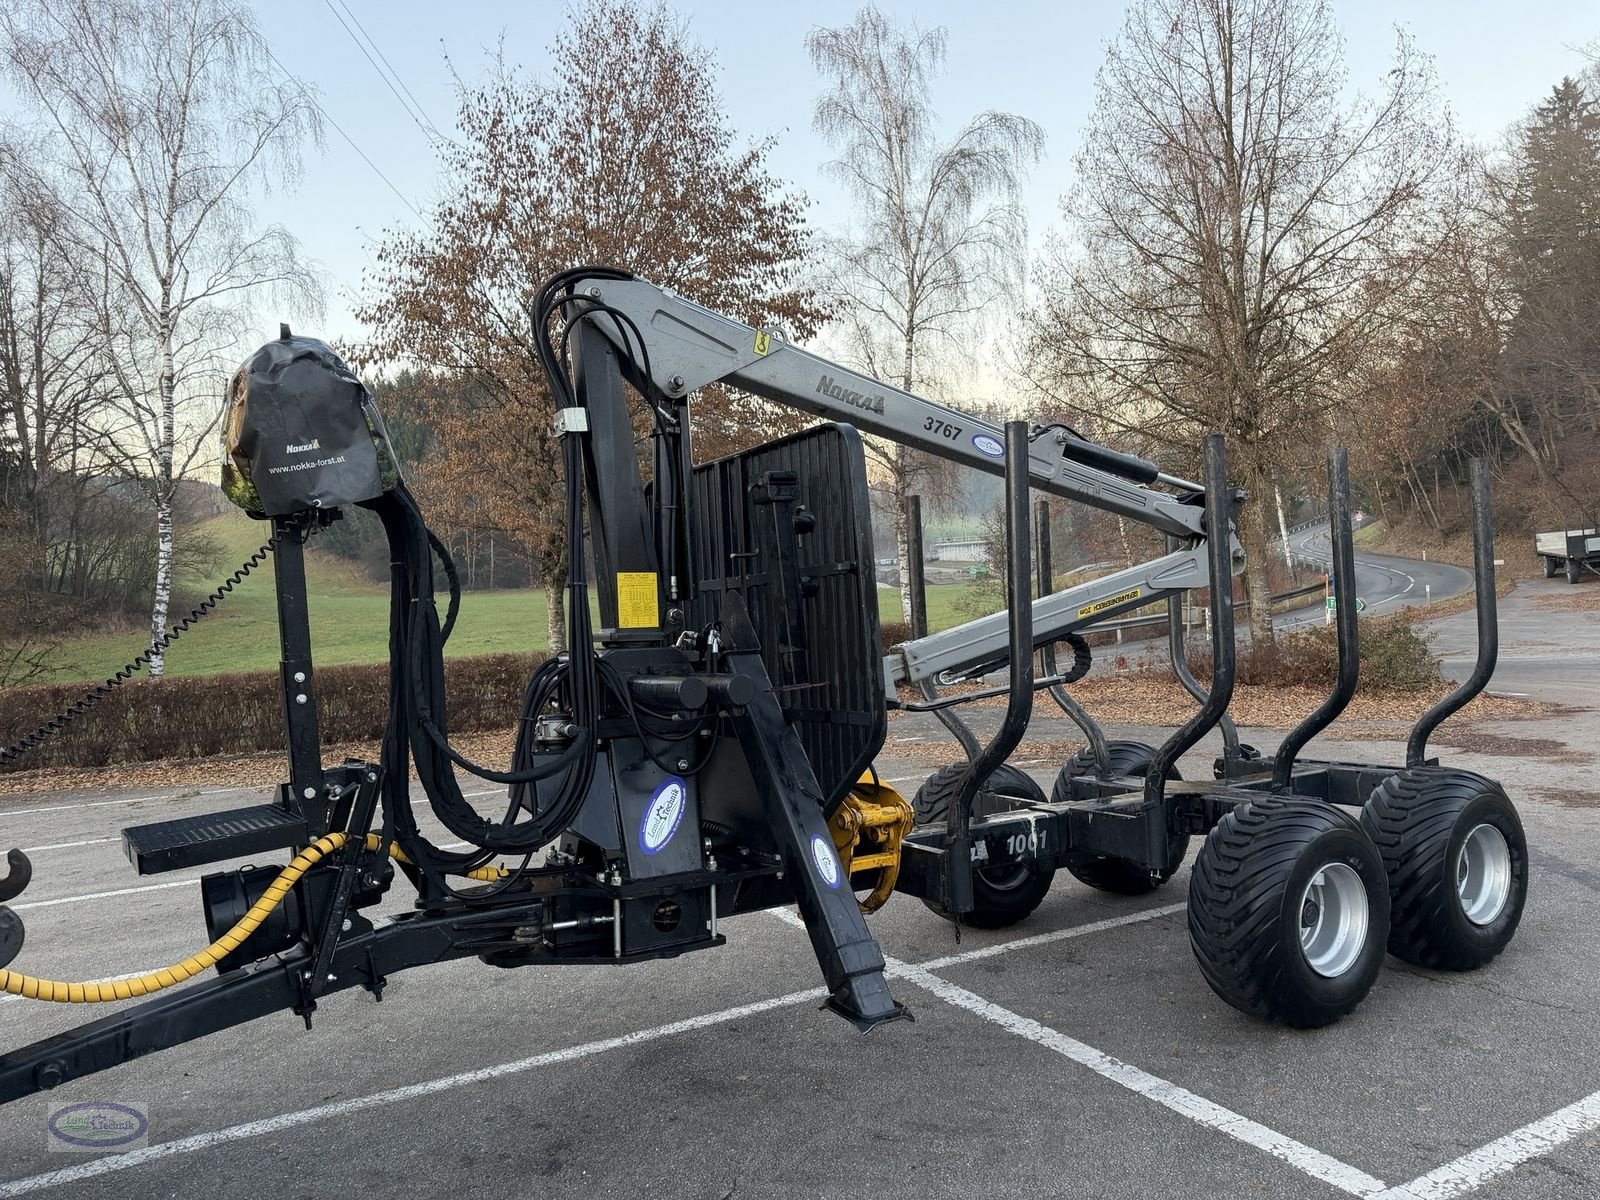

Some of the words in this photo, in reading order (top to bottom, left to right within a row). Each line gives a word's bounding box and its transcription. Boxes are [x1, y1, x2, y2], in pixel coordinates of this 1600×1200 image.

[923, 416, 962, 441] 3767
[268, 456, 346, 474] www.nokka-forst.at
[648, 817, 661, 838] Land
[663, 788, 680, 816] Technik
